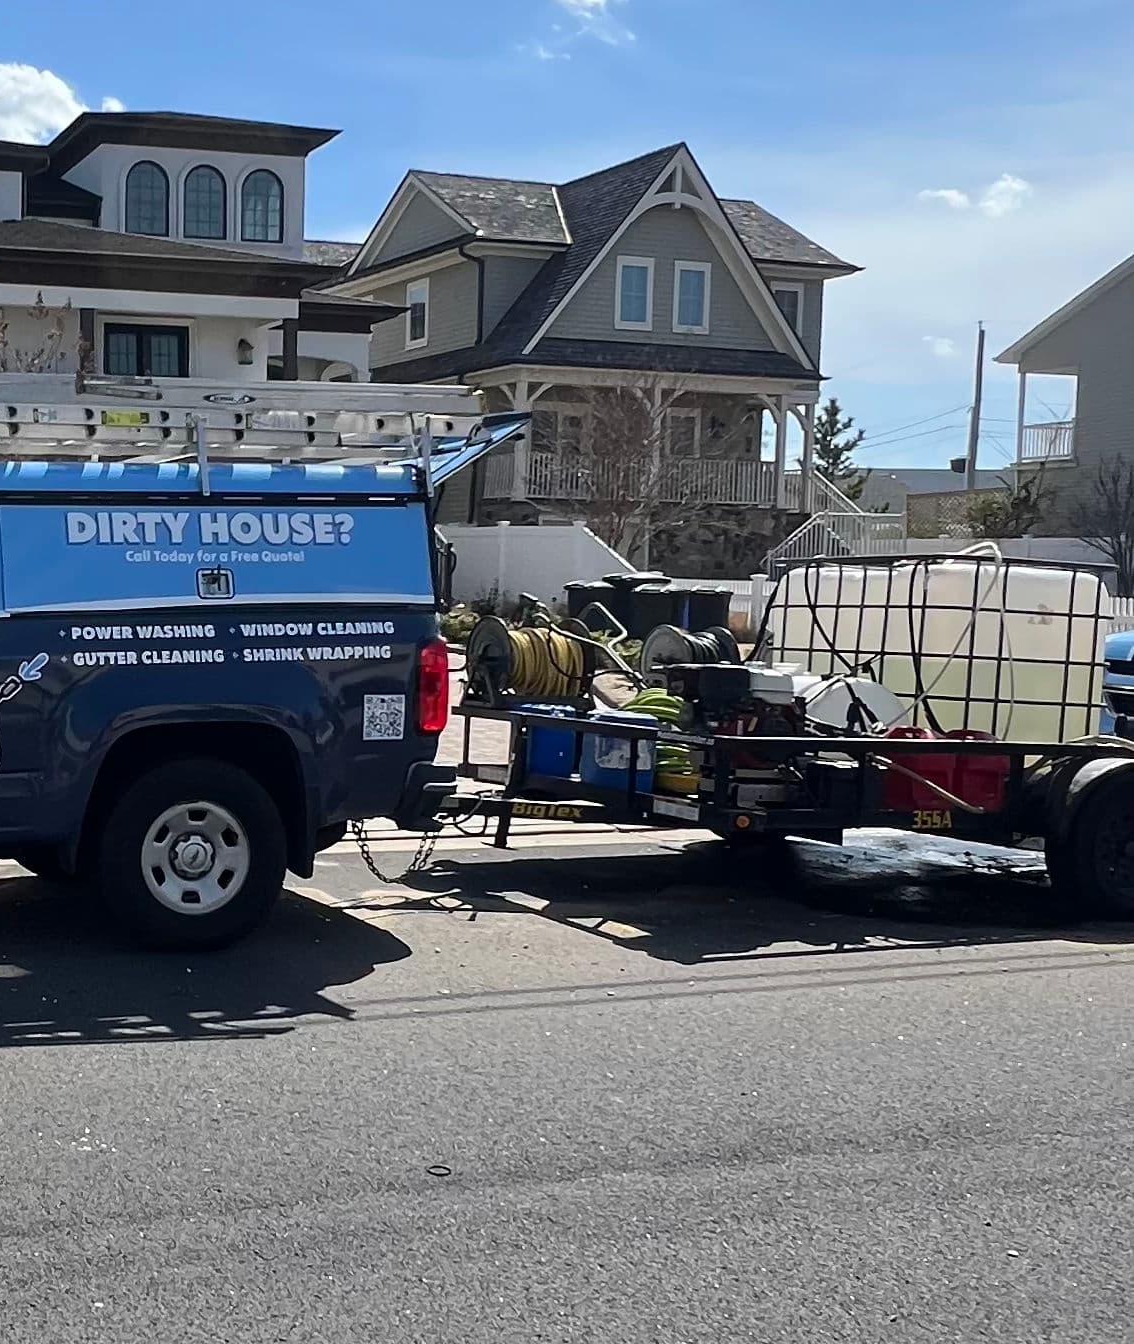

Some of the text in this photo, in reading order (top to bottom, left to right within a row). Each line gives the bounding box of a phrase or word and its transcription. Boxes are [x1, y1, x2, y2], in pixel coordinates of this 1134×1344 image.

[67, 512, 354, 545] DIRTY HOUSE?
[125, 549, 305, 564] Call Today for a Free Quote!
[71, 621, 395, 640] POWER WASHING WINDOW CLEANING
[73, 645, 392, 666] GUTTER CLEANING SHRINK WRAPPING
